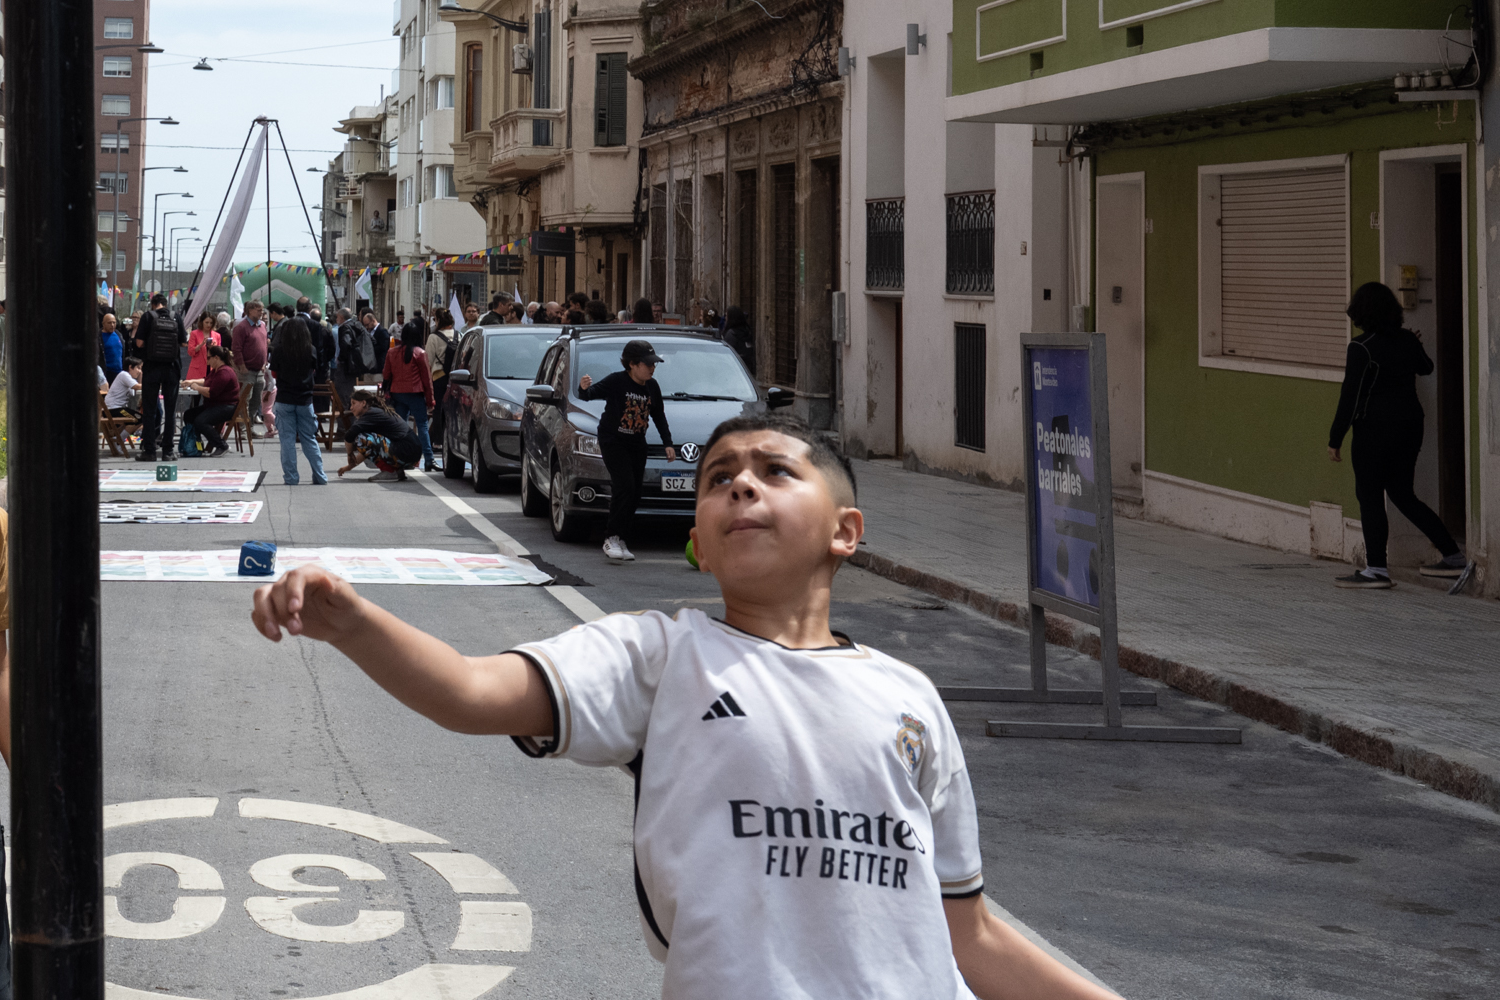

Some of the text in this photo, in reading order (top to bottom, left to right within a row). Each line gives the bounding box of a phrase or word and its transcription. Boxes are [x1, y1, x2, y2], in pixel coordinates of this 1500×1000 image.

[1036, 421, 1091, 459] Peatonales
[665, 478, 686, 490] SCZ
[1037, 459, 1082, 497] barriales
[728, 798, 926, 854] Emirates
[765, 845, 908, 890] FLY BETTER
